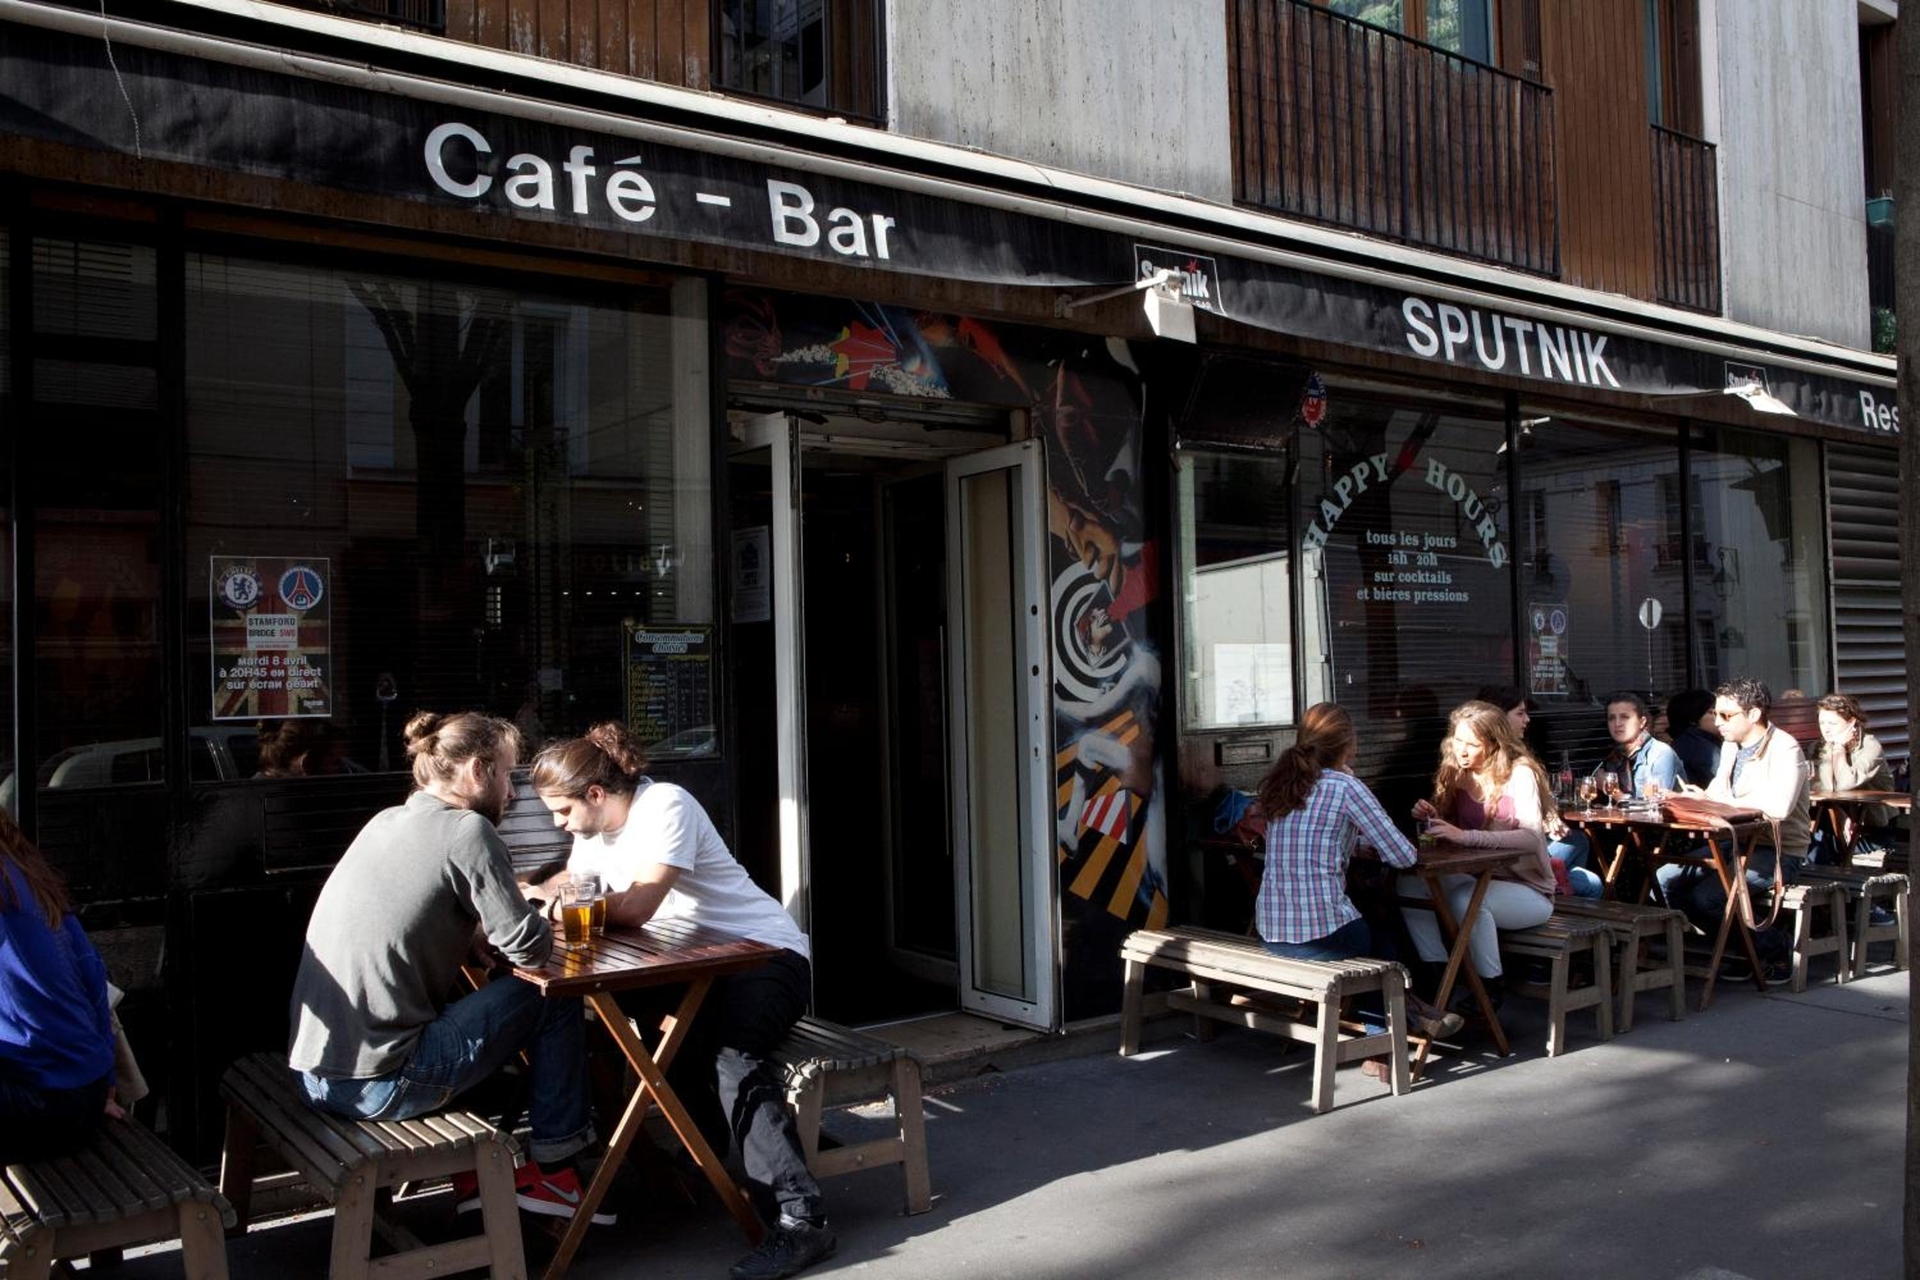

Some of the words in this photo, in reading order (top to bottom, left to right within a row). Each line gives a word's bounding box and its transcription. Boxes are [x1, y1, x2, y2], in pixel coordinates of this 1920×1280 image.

[424, 122, 656, 222] Café
[766, 178, 896, 260] Bar
[1402, 296, 1621, 388] SPUTNIK
[1303, 452, 1388, 547] HAPPY
[1425, 457, 1507, 569] HOURS
[1366, 529, 1396, 545] tous
[1400, 530, 1419, 546] les
[1422, 532, 1457, 551] jours
[1387, 551, 1408, 565] 18h
[1416, 552, 1438, 566] 20h
[1374, 571, 1395, 582] sur
[1398, 570, 1453, 584] cocktails
[1356, 589, 1370, 600] et
[1414, 588, 1470, 604] pressions
[248, 617, 296, 626] STAMFORD
[248, 629, 276, 637] BRIDGE
[283, 656, 307, 666] avril
[219, 667, 227, 678] à
[230, 667, 267, 678] 20H45
[288, 667, 322, 677] direct
[226, 681, 246, 690] sur
